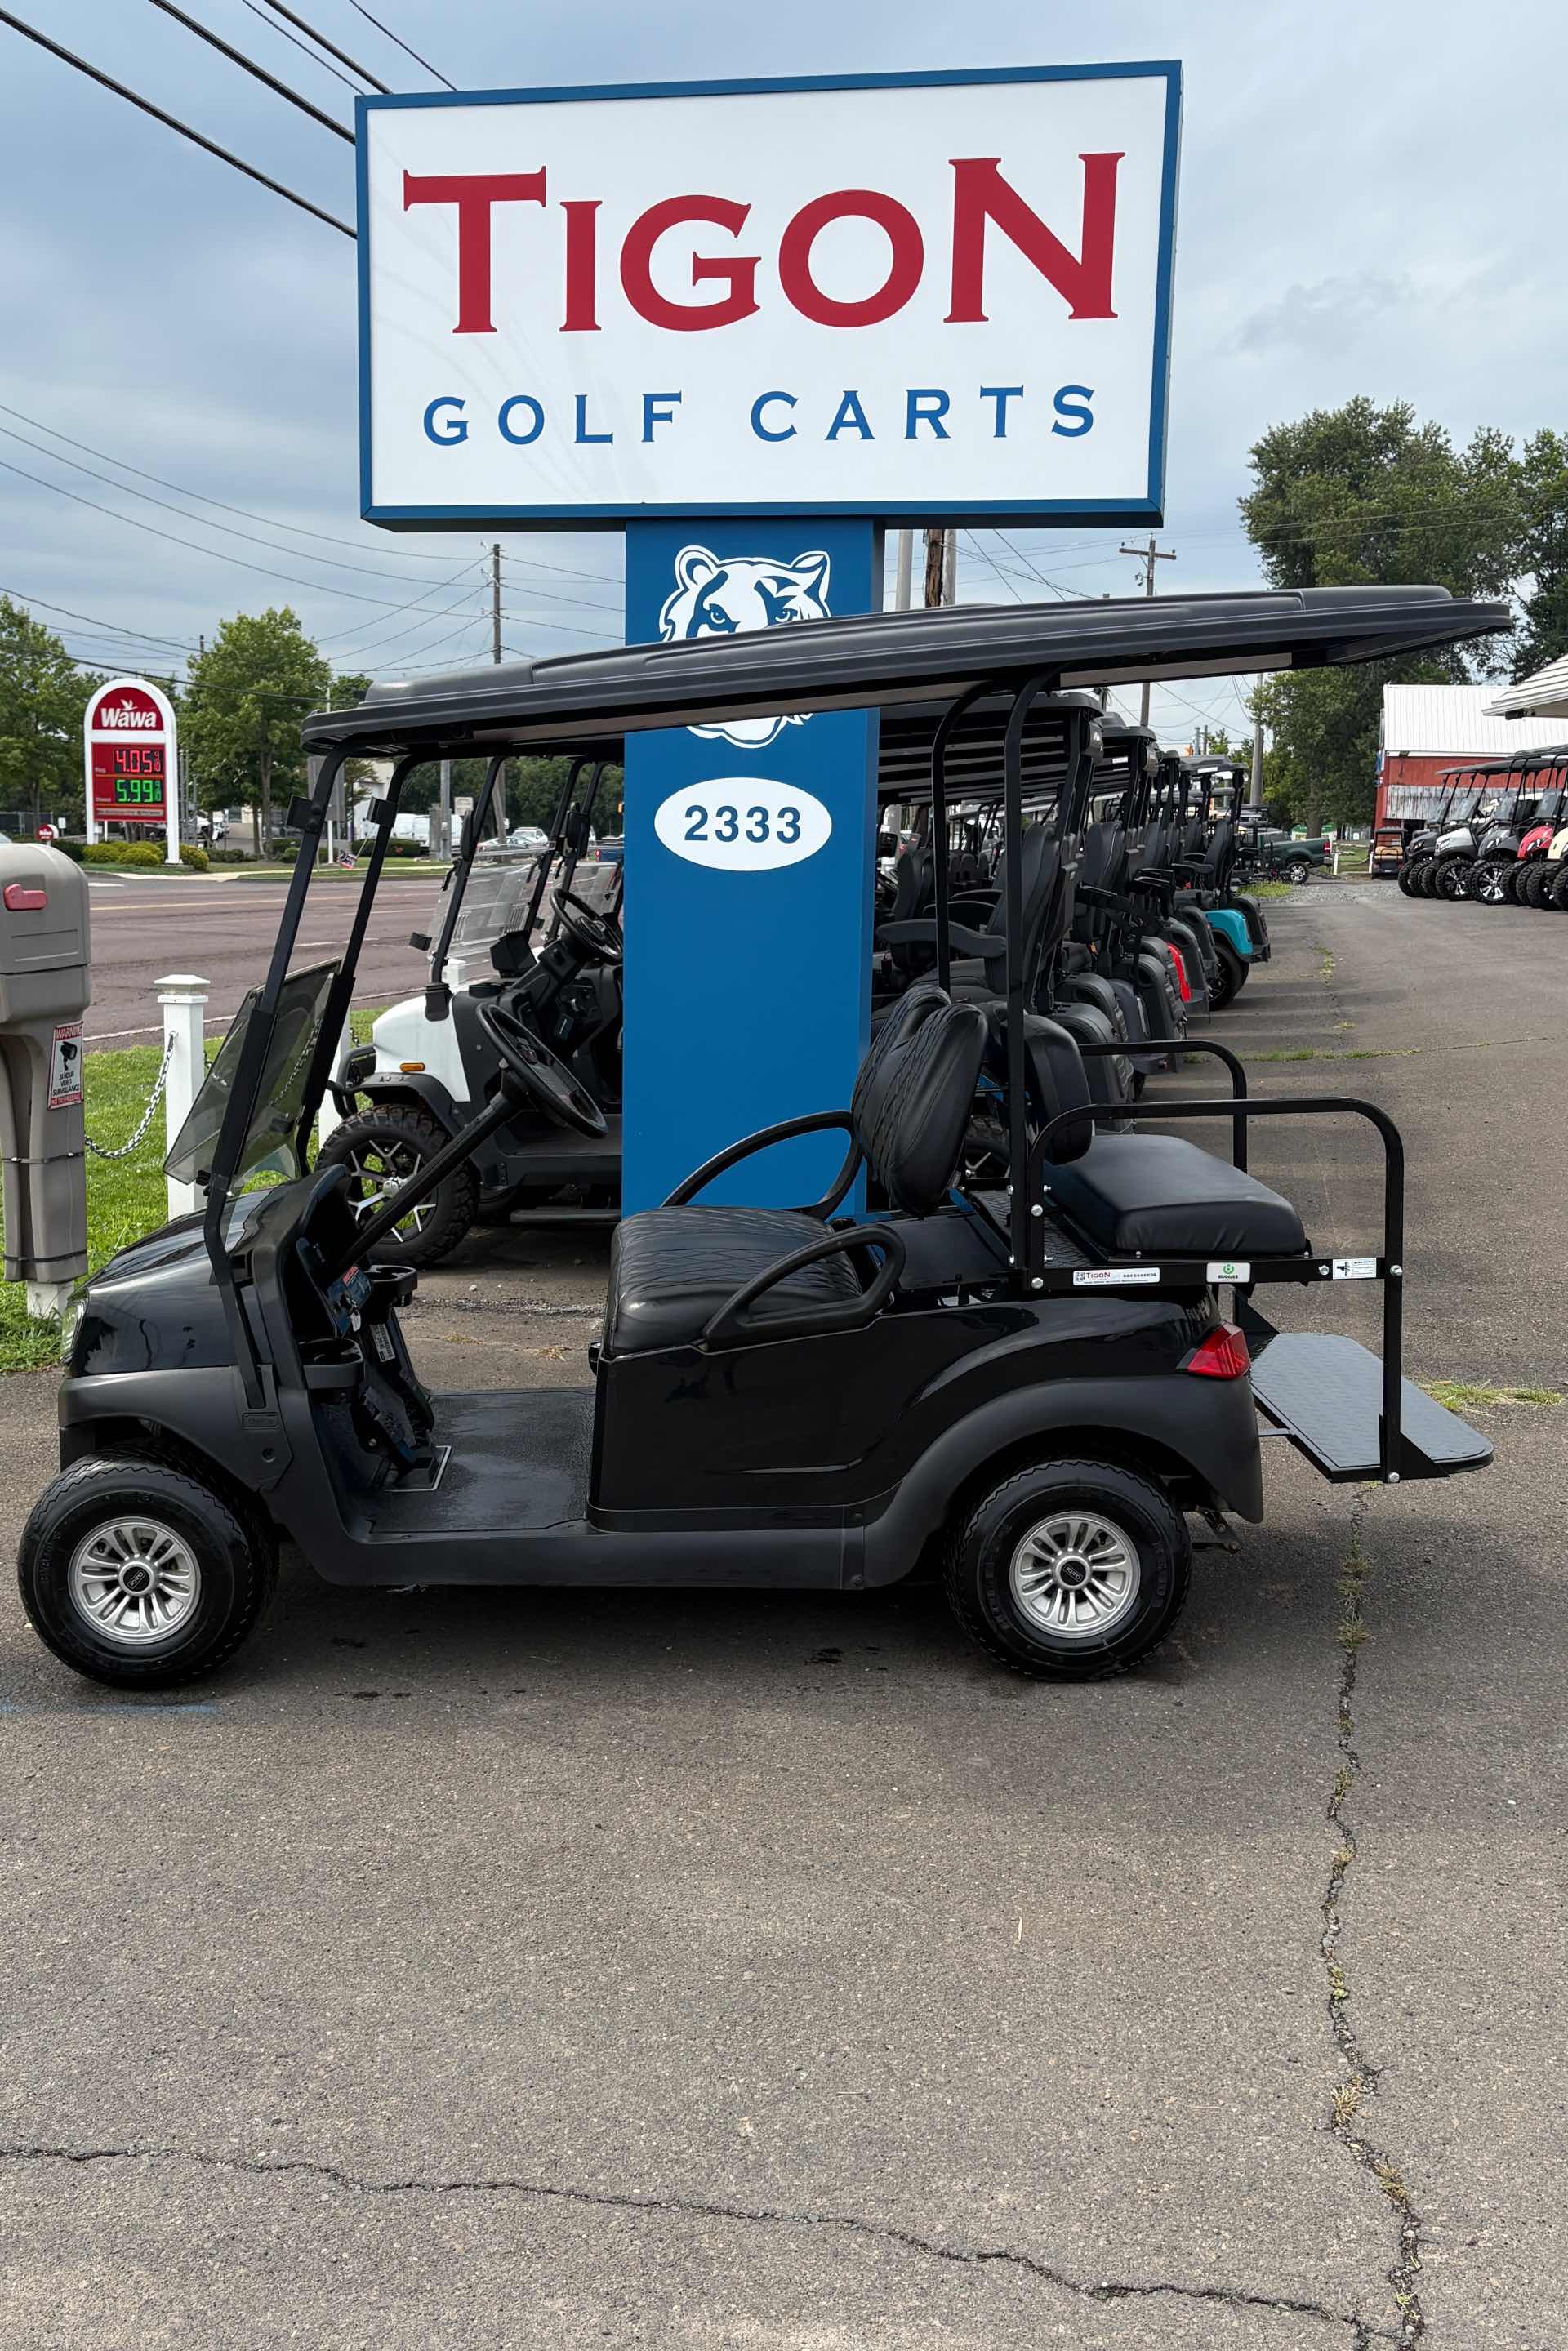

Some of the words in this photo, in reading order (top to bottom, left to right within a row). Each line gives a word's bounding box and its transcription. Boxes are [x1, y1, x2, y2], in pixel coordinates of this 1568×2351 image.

[403, 153, 1125, 334] TIGON
[423, 392, 682, 446] GOLF
[750, 385, 1094, 443] CARTS
[100, 708, 156, 728] Wawa
[684, 804, 801, 844] 2333
